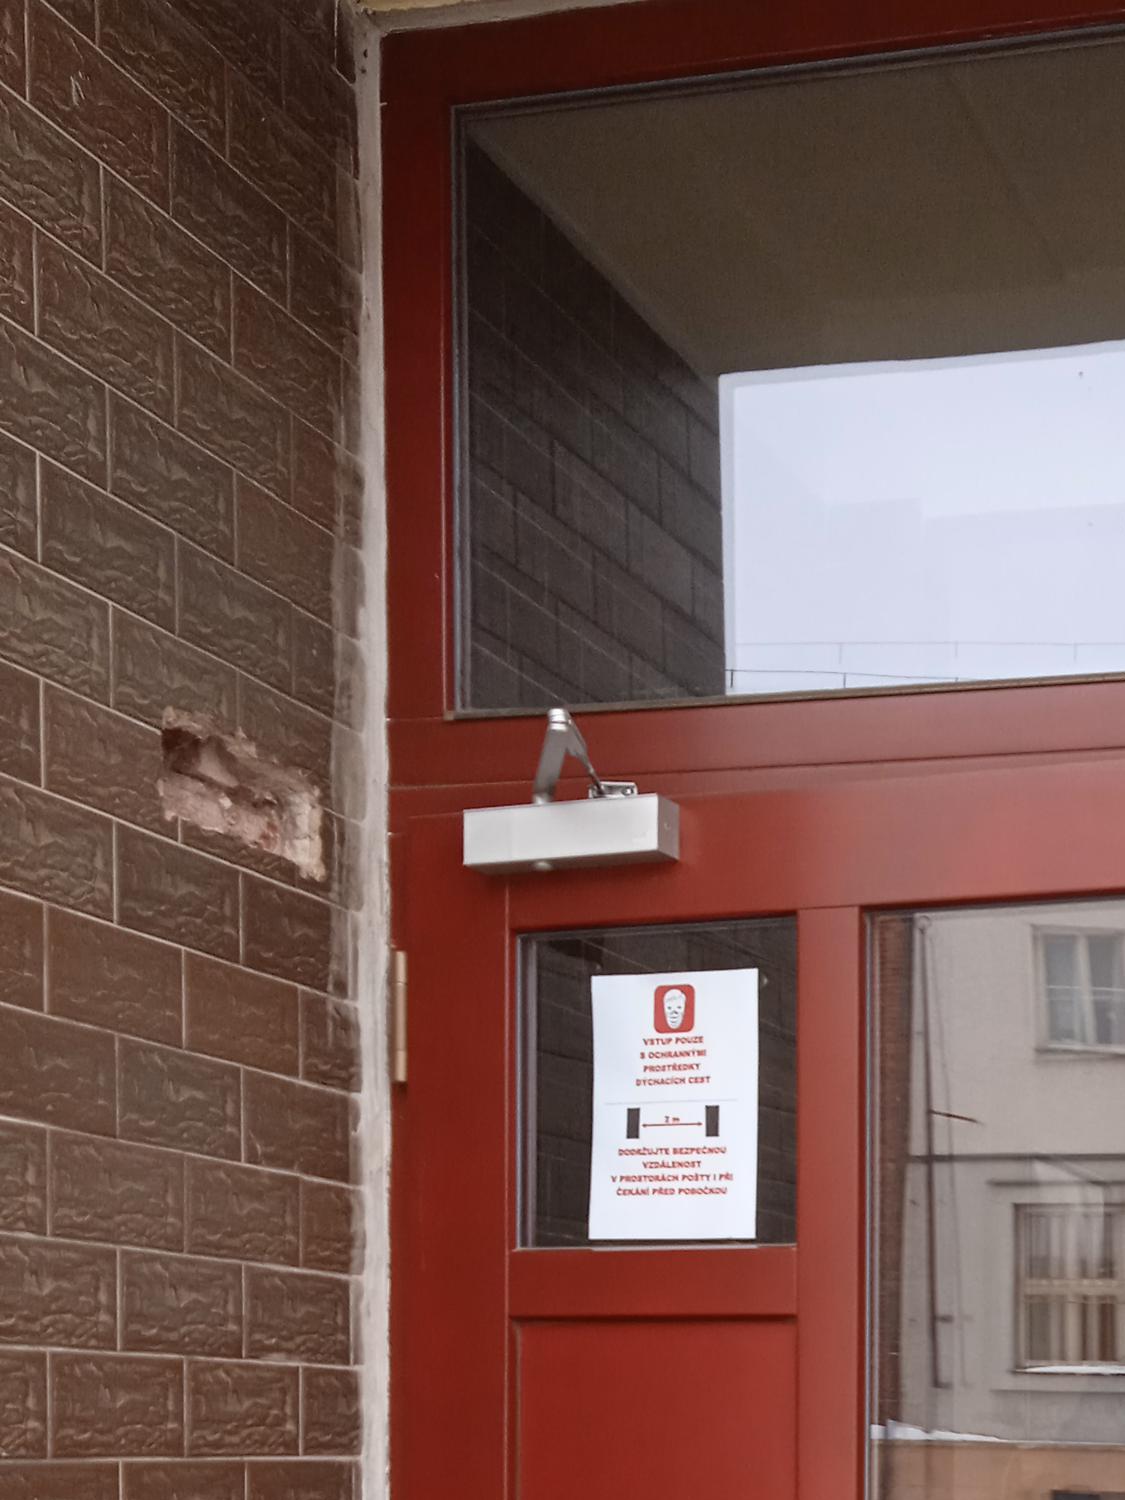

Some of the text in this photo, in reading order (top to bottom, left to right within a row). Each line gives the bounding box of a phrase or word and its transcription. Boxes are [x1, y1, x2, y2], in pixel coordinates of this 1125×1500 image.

[643, 1036, 704, 1046] VSTUP POUZE
[688, 1076, 711, 1084] CEST
[672, 1145, 727, 1155] BEZPEČNOU
[642, 1160, 702, 1169] VZDÁLENOST
[682, 1173, 711, 1181] POŠTY
[652, 1186, 675, 1195] PŘED
[678, 1186, 728, 1195] POBOČKOU
